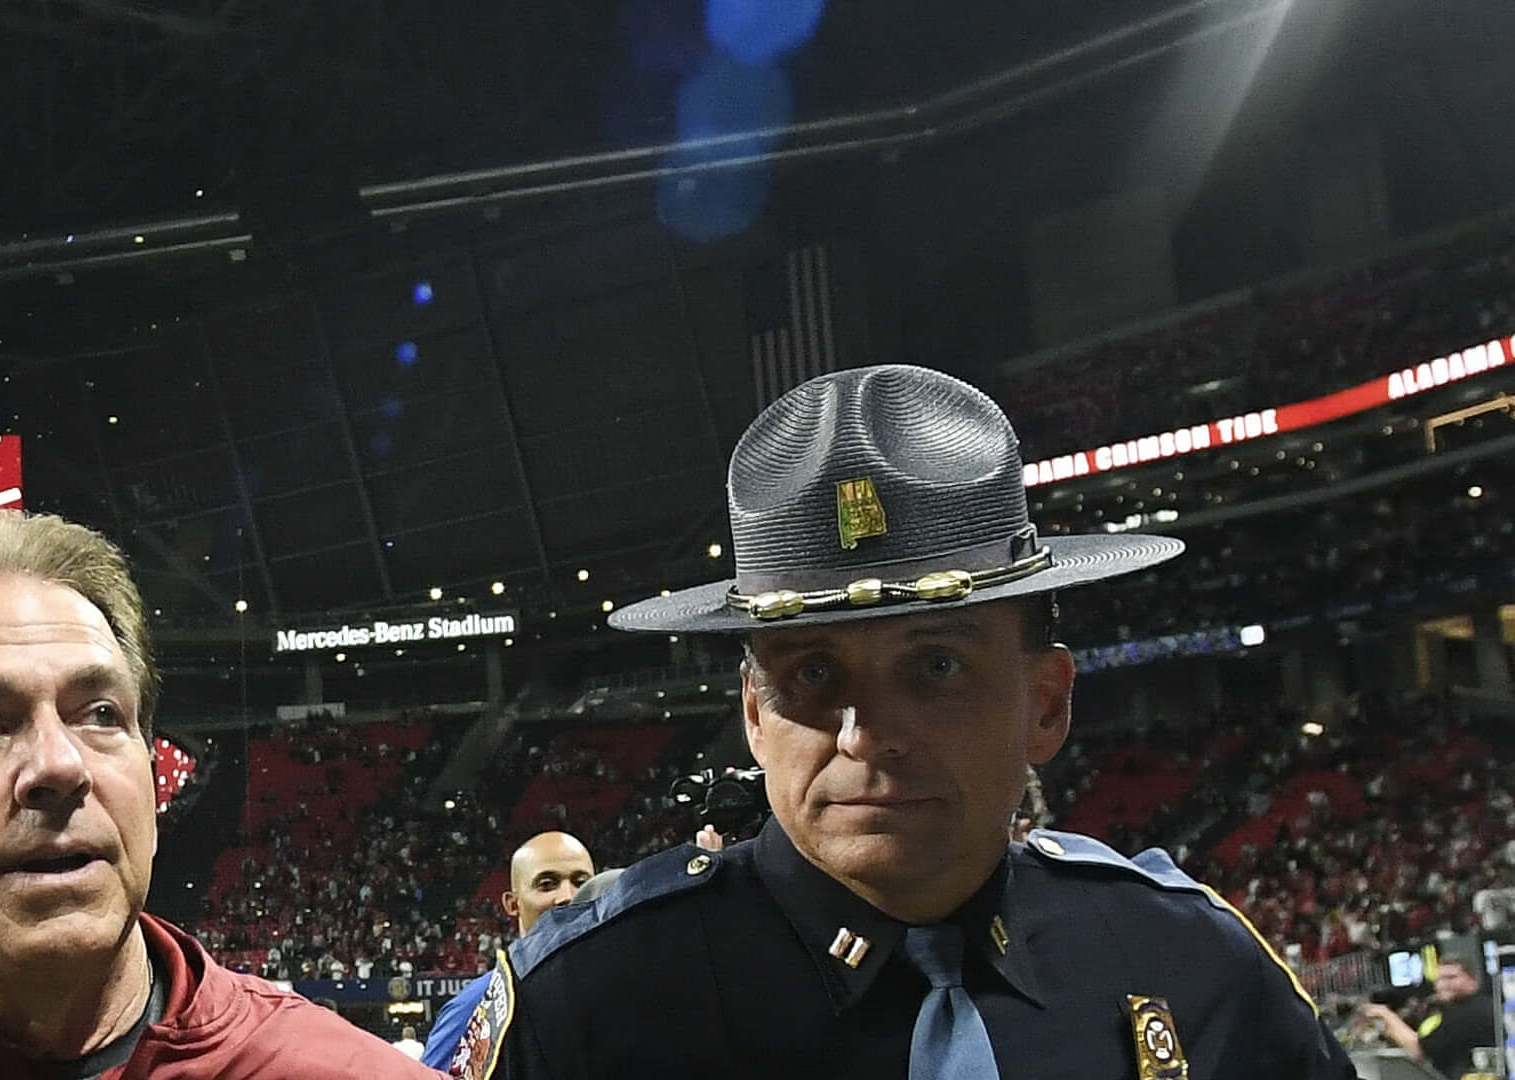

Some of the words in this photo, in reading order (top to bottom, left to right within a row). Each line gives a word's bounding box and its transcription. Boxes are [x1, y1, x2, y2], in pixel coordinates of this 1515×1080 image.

[1023, 451, 1090, 487] BAMA
[1095, 423, 1211, 471] CRIMSON
[1217, 408, 1279, 444] TIDE
[276, 620, 426, 652] Mercedes-Benz
[427, 612, 516, 640] Stadium
